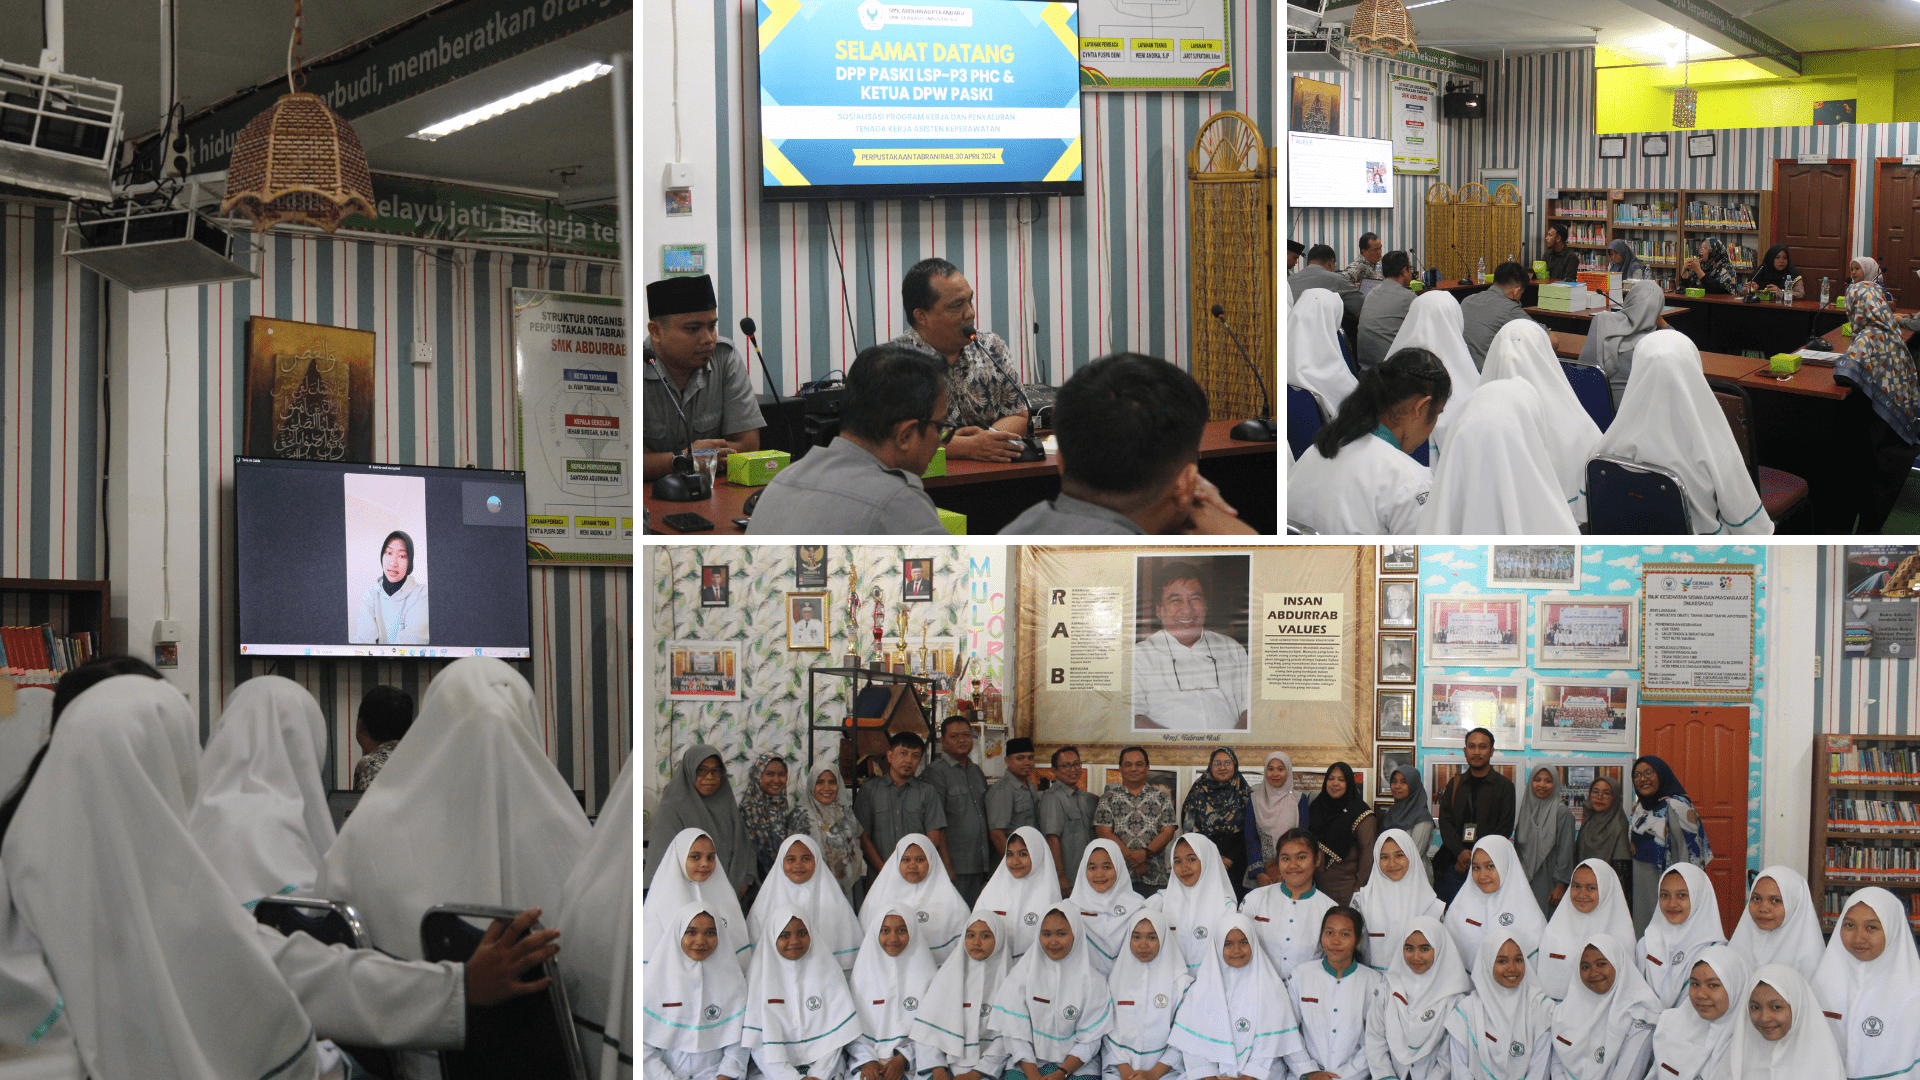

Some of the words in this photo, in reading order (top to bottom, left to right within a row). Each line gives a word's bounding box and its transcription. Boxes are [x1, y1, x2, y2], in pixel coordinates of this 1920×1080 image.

[389, 10, 536, 87] memberatkan
[835, 40, 928, 62] SELAMAT
[934, 42, 1014, 63] DATANG
[836, 67, 866, 80] DPP
[870, 67, 914, 82] PASKI
[917, 68, 968, 82] LSP-P3
[971, 69, 1000, 83] PHC
[1003, 69, 1015, 83] &
[861, 86, 910, 100] KETUA
[913, 86, 948, 100] DPW
[951, 87, 994, 100] PASKI
[378, 194, 444, 226] elayu
[449, 196, 494, 230] jati,
[501, 206, 587, 244] bekerja
[542, 311, 586, 324] STRUKTUR
[530, 322, 593, 336] PERPUSTAKAAN
[551, 339, 572, 352] SMK
[1051, 589, 1066, 605] R
[1283, 597, 1322, 606] INSAN
[1267, 610, 1338, 620] ABDURRAB
[1050, 622, 1069, 638] A
[1278, 625, 1327, 634] VALUES
[1051, 668, 1065, 684] B
